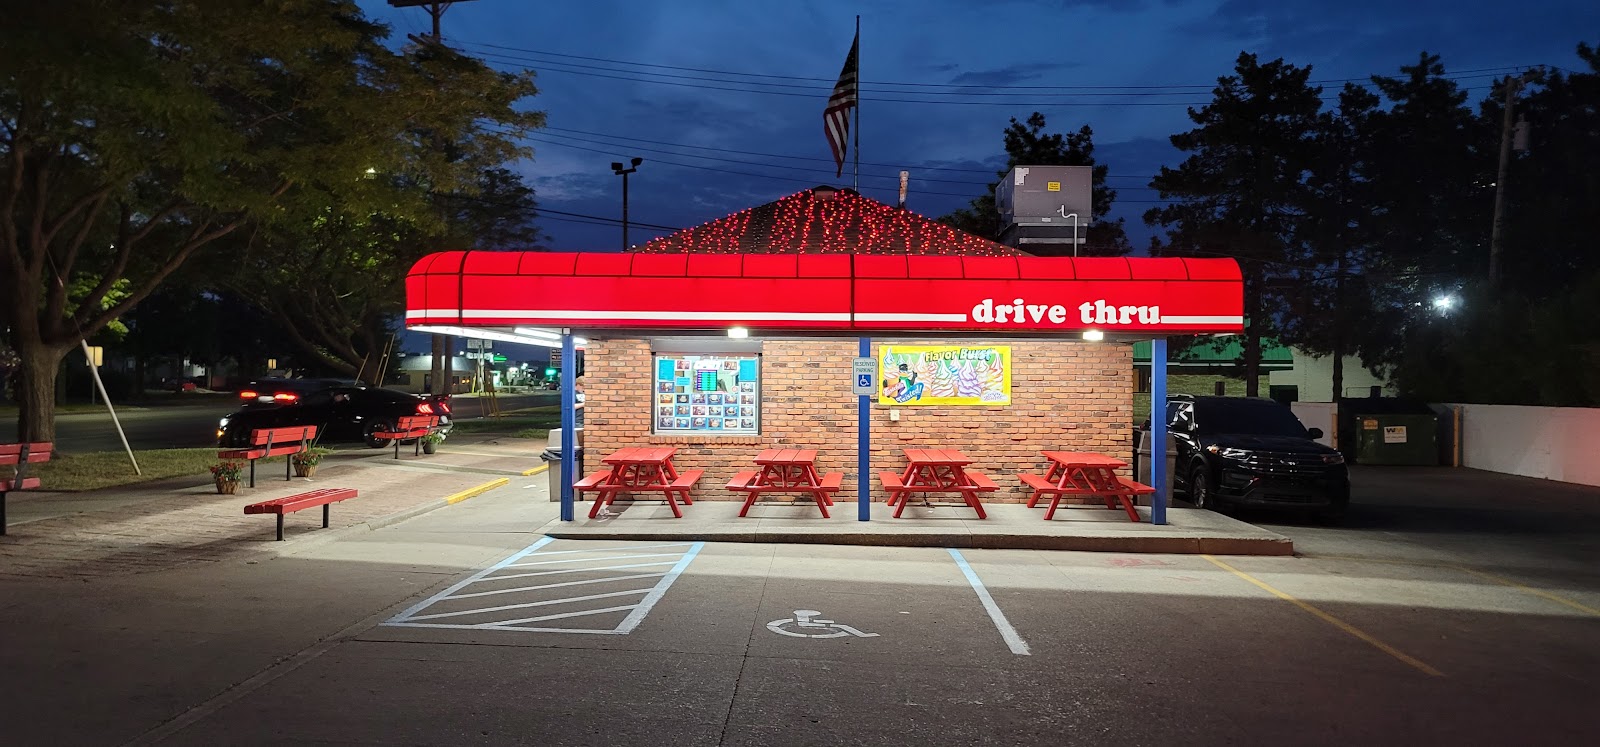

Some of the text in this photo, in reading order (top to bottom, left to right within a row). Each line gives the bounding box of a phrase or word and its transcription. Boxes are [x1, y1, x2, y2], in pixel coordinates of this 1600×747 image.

[972, 298, 1161, 324] drive thru
[925, 347, 992, 362] Flavor Burst
